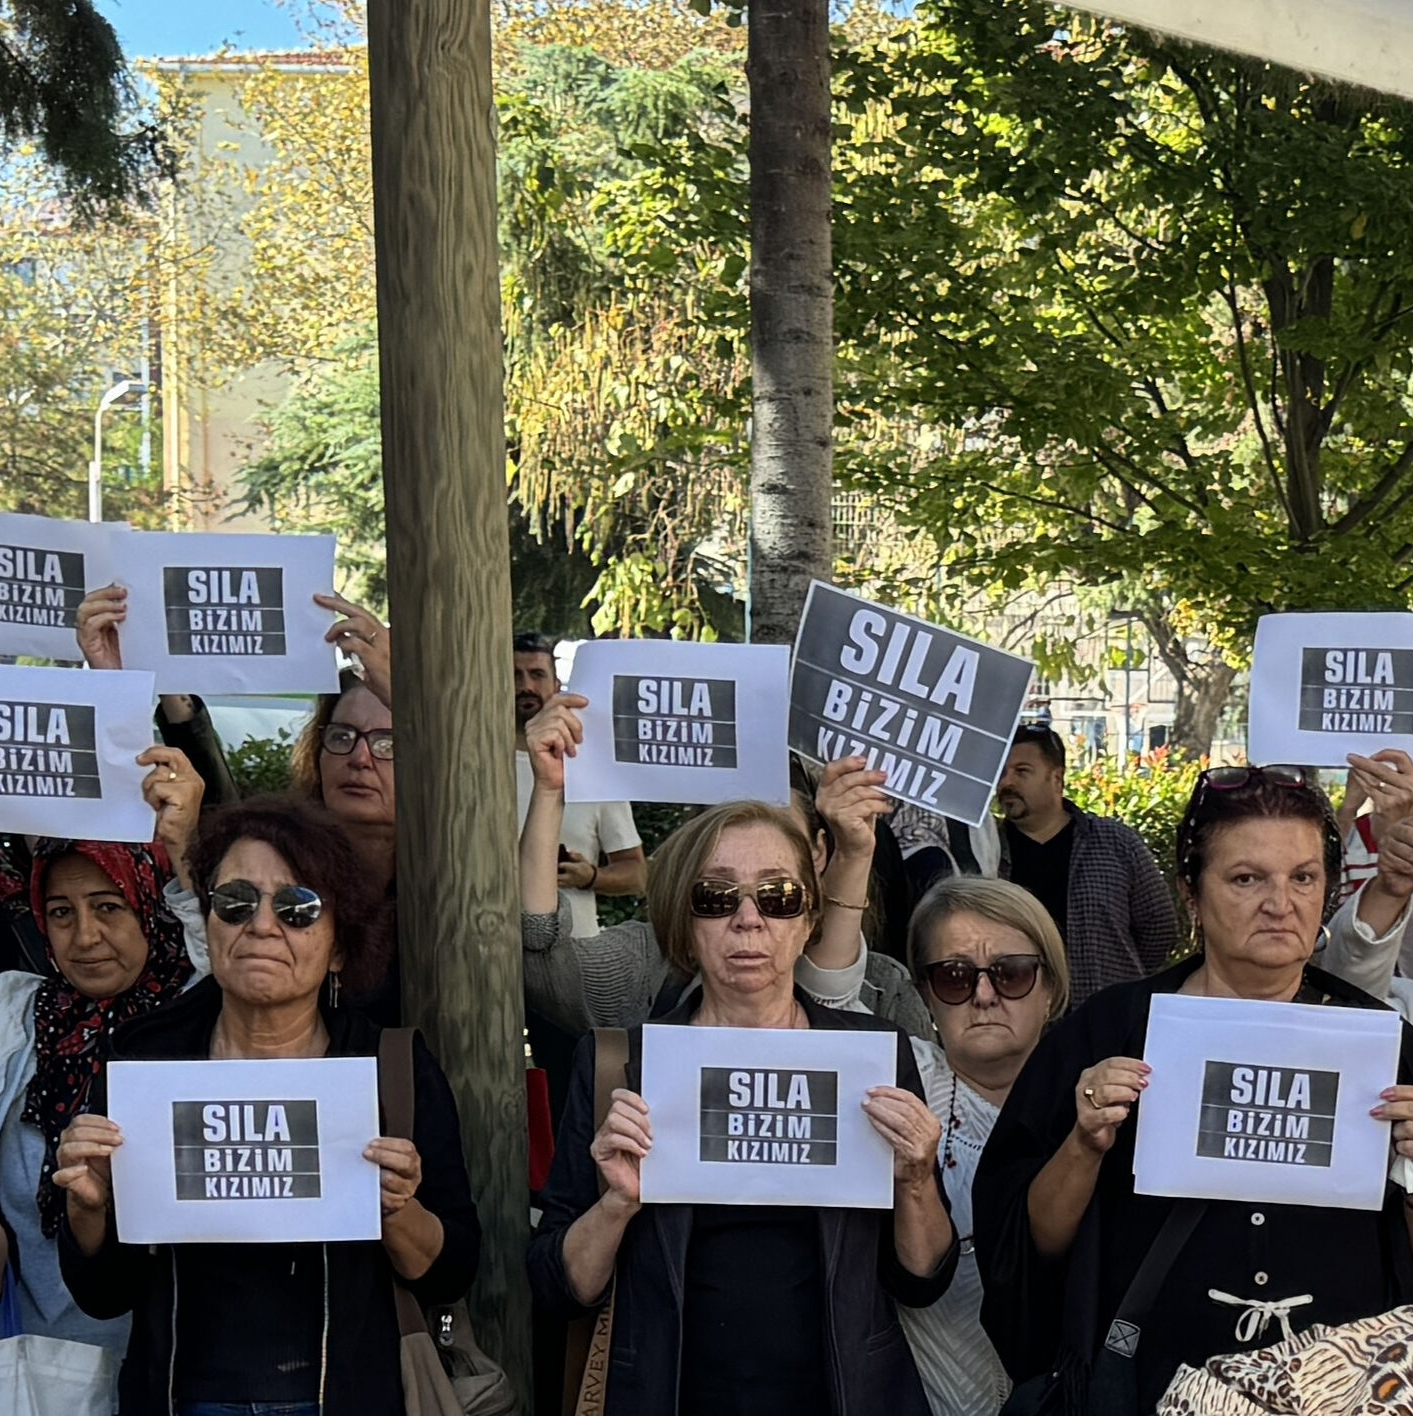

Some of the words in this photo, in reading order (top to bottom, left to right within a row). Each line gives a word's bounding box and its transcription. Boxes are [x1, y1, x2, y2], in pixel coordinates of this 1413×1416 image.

[188, 571, 260, 605] SILA
[190, 633, 264, 655] KIZIMIZ
[840, 608, 980, 715] SILA
[1324, 650, 1395, 684] SILA
[637, 679, 712, 716] SILA
[1322, 711, 1394, 734] KIZIMIZ
[638, 744, 714, 767] KIZIMIZ
[728, 1071, 810, 1109] SILA
[1229, 1068, 1311, 1109] SILA
[202, 1104, 289, 1143] SILA
[726, 1139, 810, 1165] KIZIMIZ
[1223, 1136, 1307, 1163] KIZIMIZ
[205, 1175, 294, 1198] KIZIMIZ
